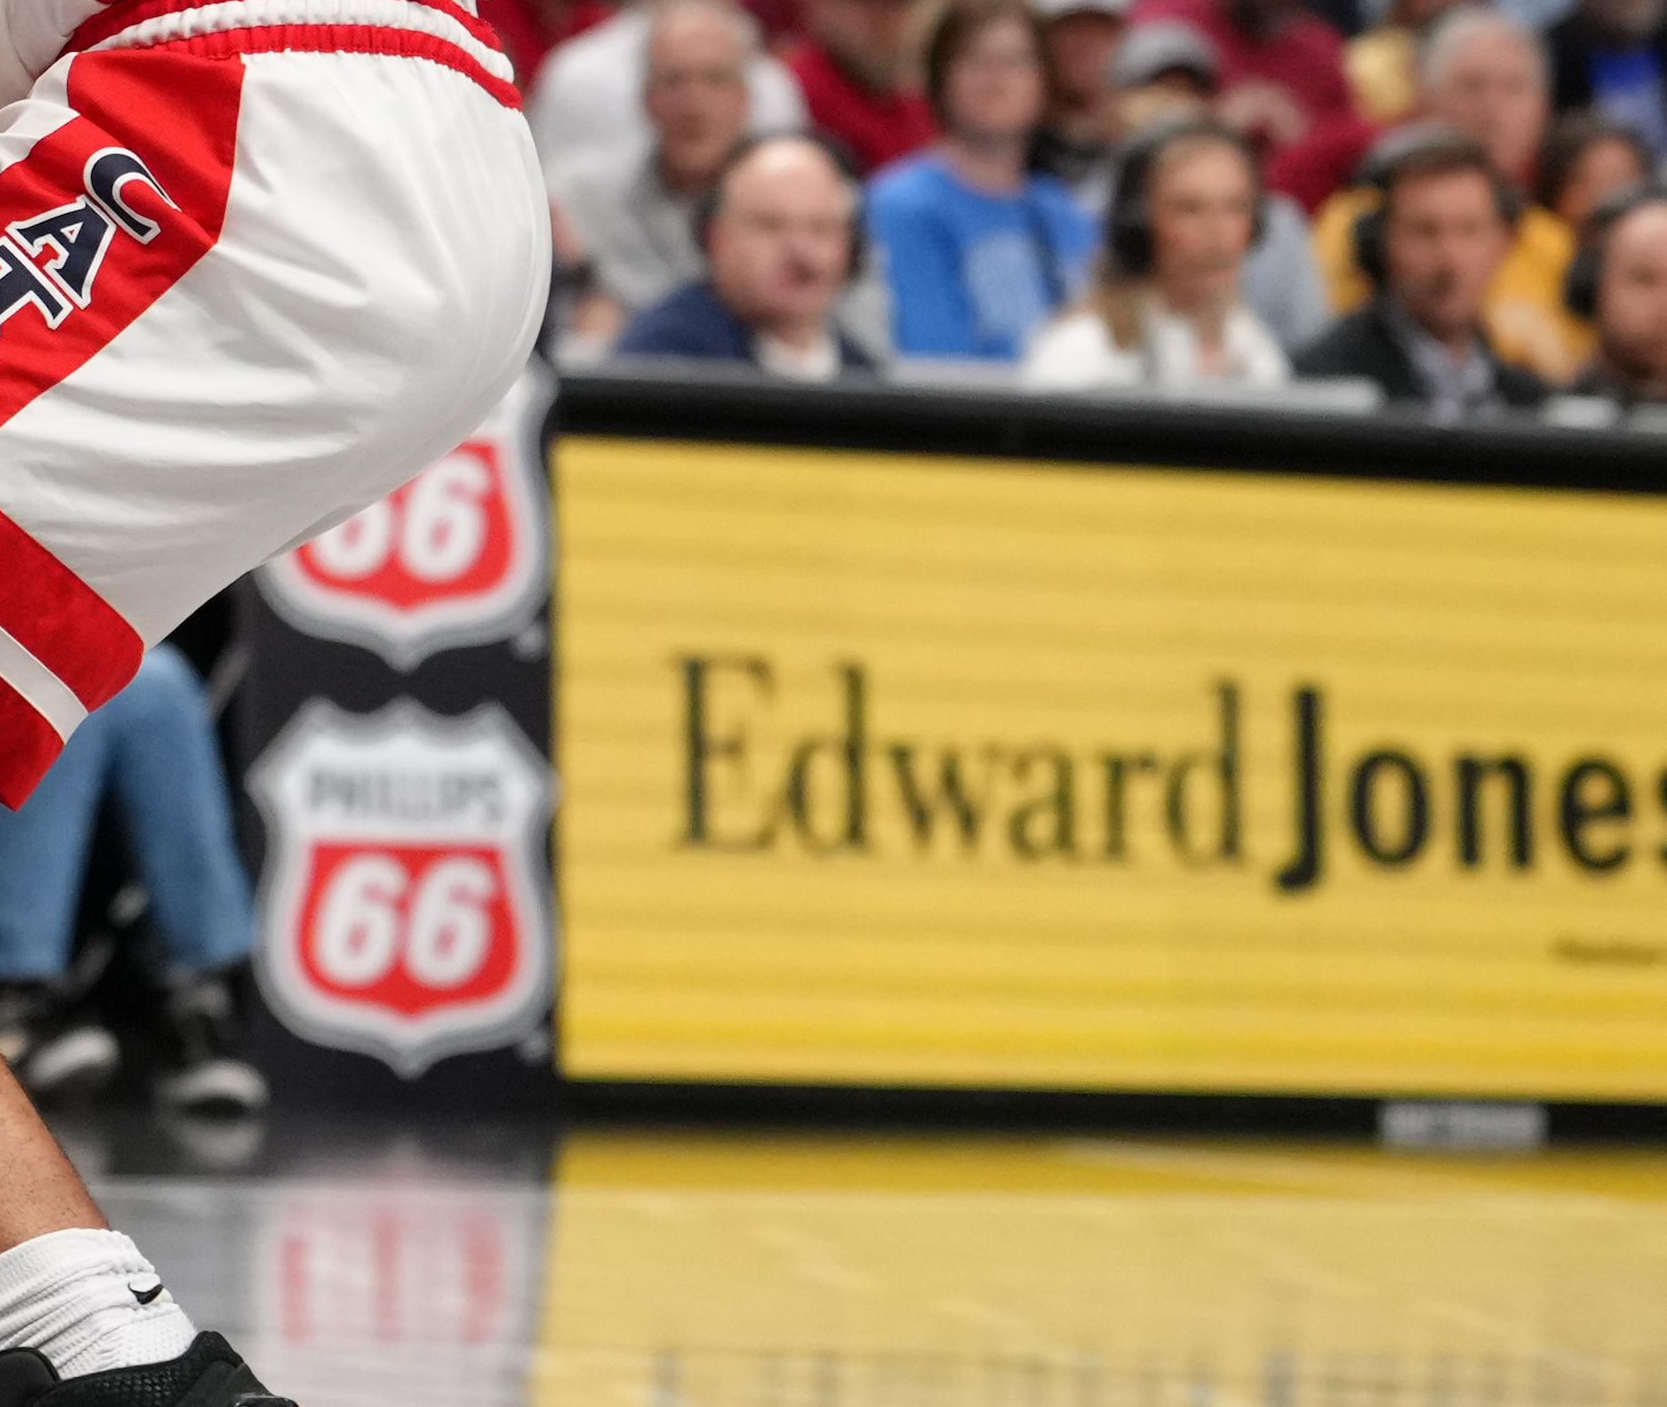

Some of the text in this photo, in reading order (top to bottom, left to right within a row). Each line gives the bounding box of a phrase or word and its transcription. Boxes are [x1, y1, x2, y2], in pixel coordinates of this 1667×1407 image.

[675, 654, 1667, 894] Edward Jone
[318, 851, 496, 989] 66
